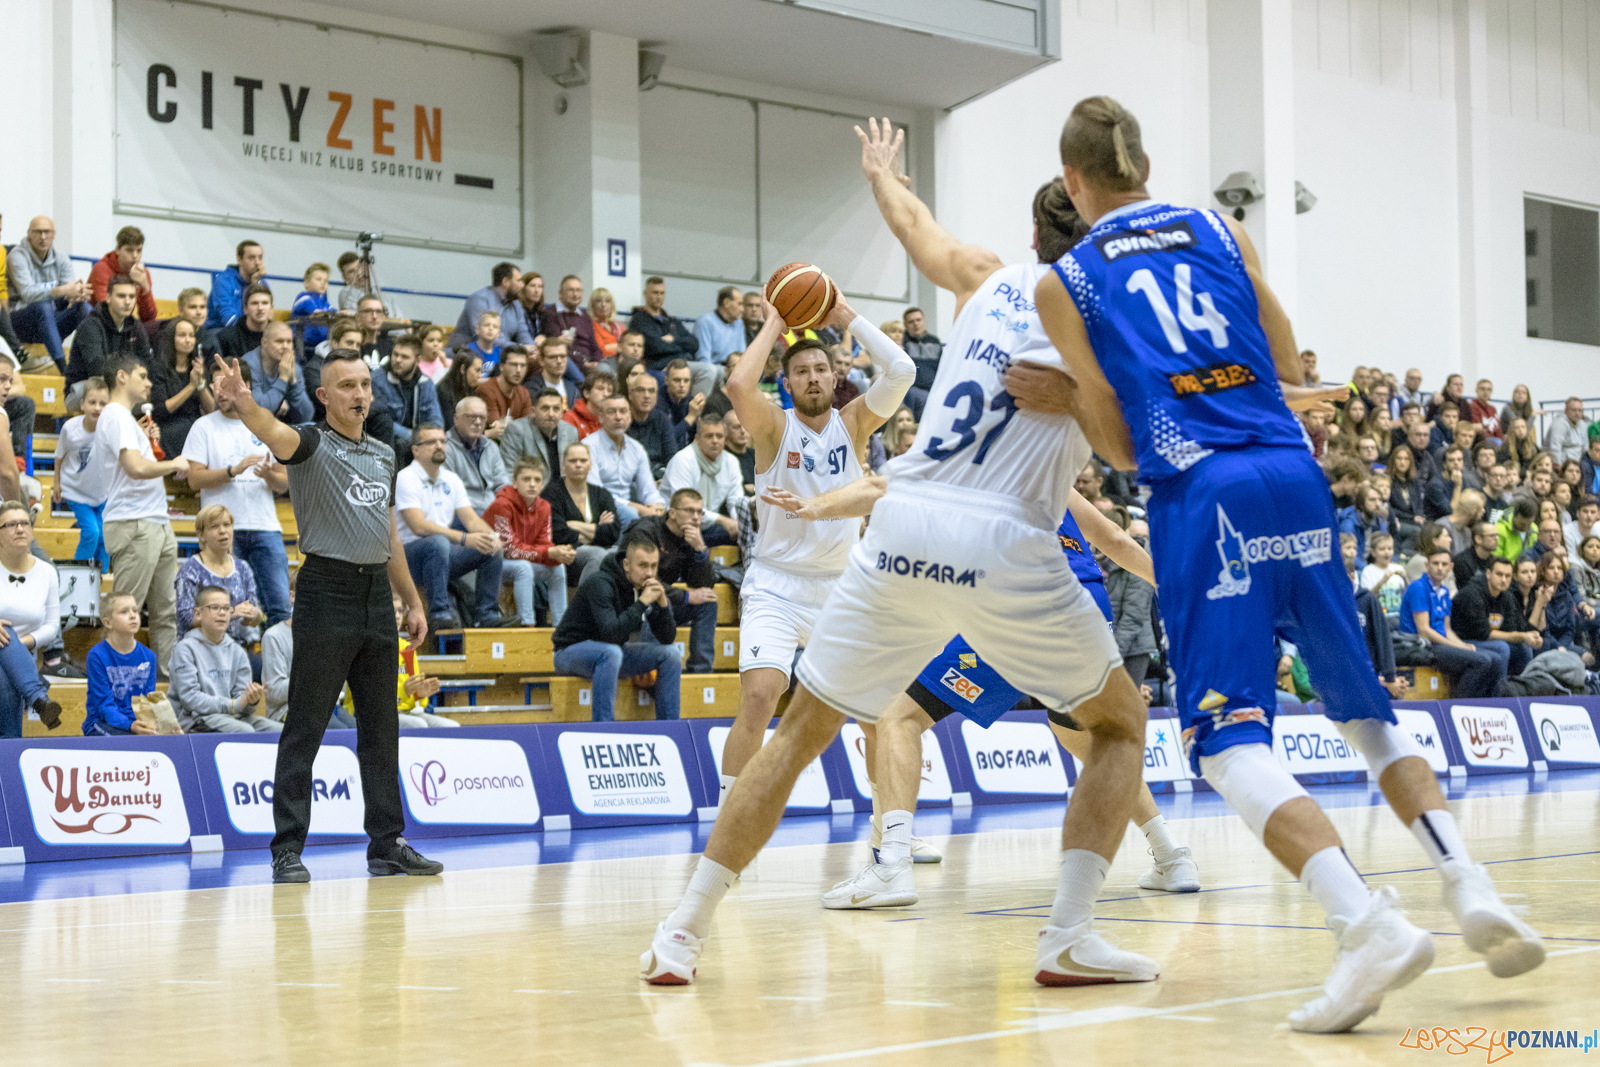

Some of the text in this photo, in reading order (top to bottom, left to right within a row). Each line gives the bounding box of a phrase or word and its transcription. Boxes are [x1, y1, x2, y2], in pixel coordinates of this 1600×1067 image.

[146, 63, 442, 163] CITYZEN
[330, 157, 364, 172] KLUB
[371, 160, 442, 182] SPORTOWY
[611, 244, 624, 271] B
[1126, 263, 1230, 354] 14
[827, 445, 848, 475] 97
[1246, 529, 1331, 562] OPOLSKIE
[876, 551, 977, 588] BIOFARM
[581, 742, 661, 769] HELMEX
[976, 748, 1052, 770] BIOFARM
[40, 765, 151, 813] U leniwej
[232, 778, 351, 806] BIORM
[453, 775, 525, 795] posnania
[588, 771, 666, 790] EXHIBITIONS
[88, 785, 162, 809] Danuty
[593, 796, 671, 808] AGENCJA REKLAMOWA
